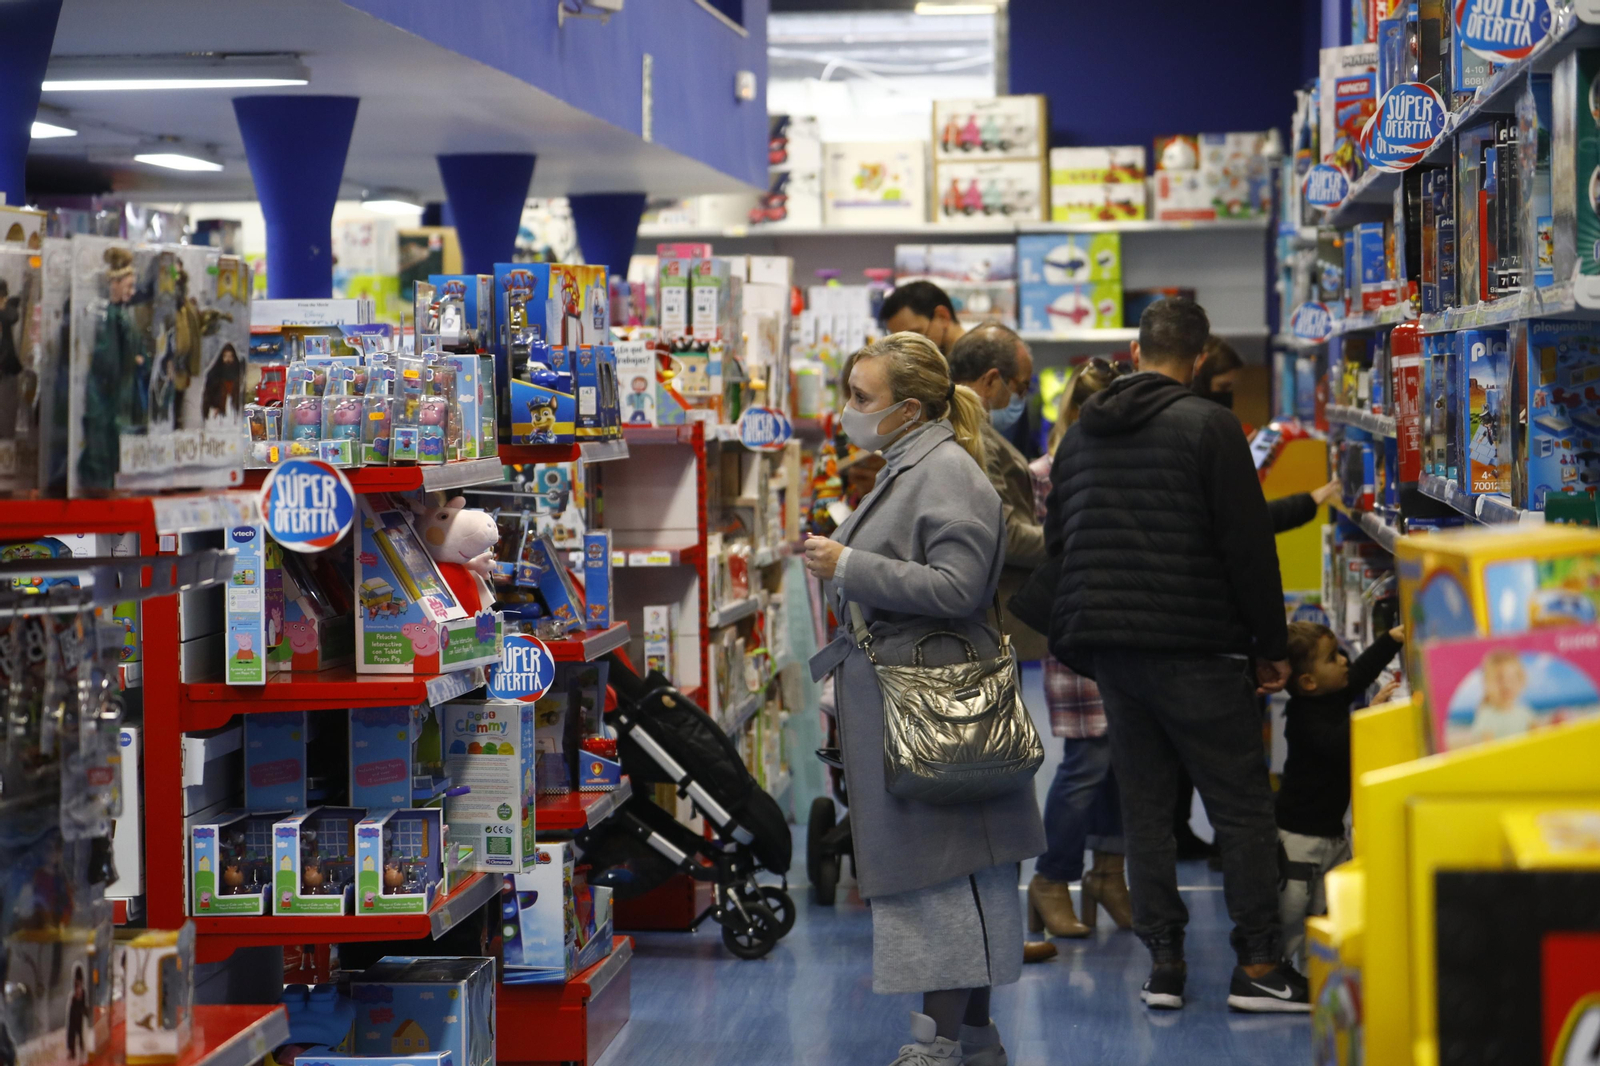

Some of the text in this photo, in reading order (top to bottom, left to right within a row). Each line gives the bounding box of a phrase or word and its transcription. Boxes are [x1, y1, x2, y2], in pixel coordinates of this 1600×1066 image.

[1466, 12, 1533, 46] OFERTTA
[1465, 66, 1484, 74] 4-10
[1387, 90, 1434, 121] SÚPER
[1385, 119, 1433, 139] OFERTTA
[1310, 167, 1342, 189] SÚPER
[1533, 321, 1593, 334] playmobil
[275, 467, 338, 509] SÚPER
[274, 507, 340, 533] OFERTTA
[374, 656, 401, 664] Peppa Pig
[494, 672, 543, 692] OFERTTA
[455, 719, 508, 733] Clemmy
